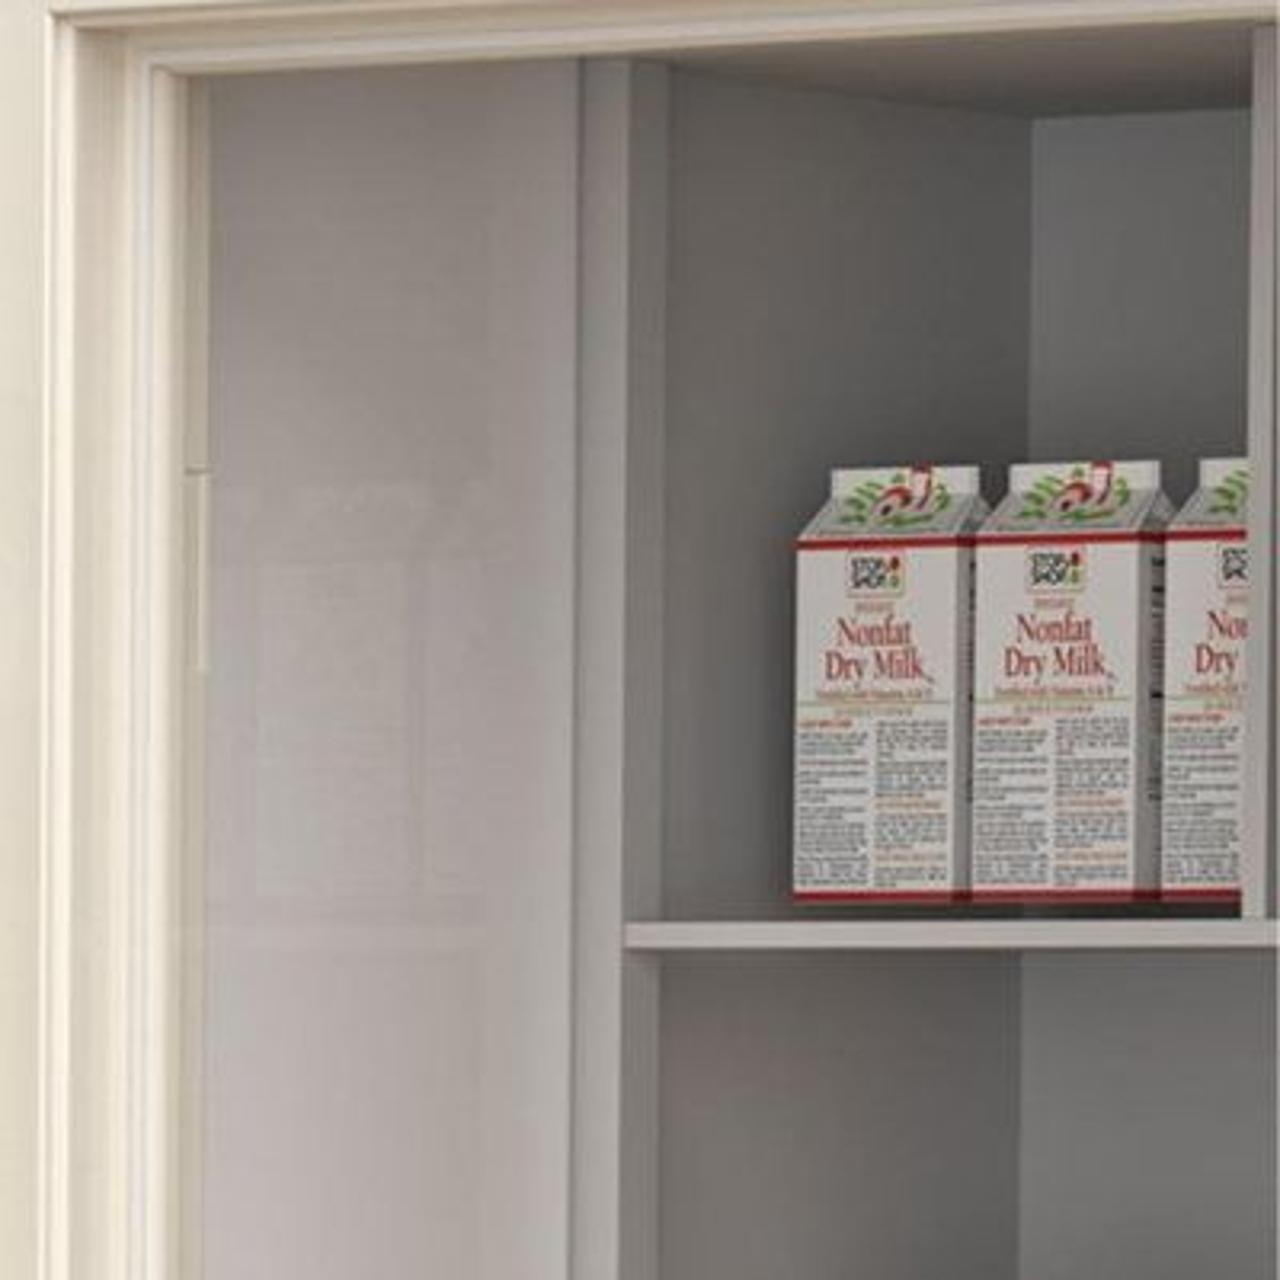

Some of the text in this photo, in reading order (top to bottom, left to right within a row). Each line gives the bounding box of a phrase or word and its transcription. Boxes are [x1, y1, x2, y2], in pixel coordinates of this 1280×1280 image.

[837, 616, 912, 645] Nonfat
[1015, 613, 1093, 643] Nonfat
[824, 650, 924, 688] Dry Milk
[1004, 646, 1105, 685] Dry Milk
[1195, 644, 1237, 681] Dry
